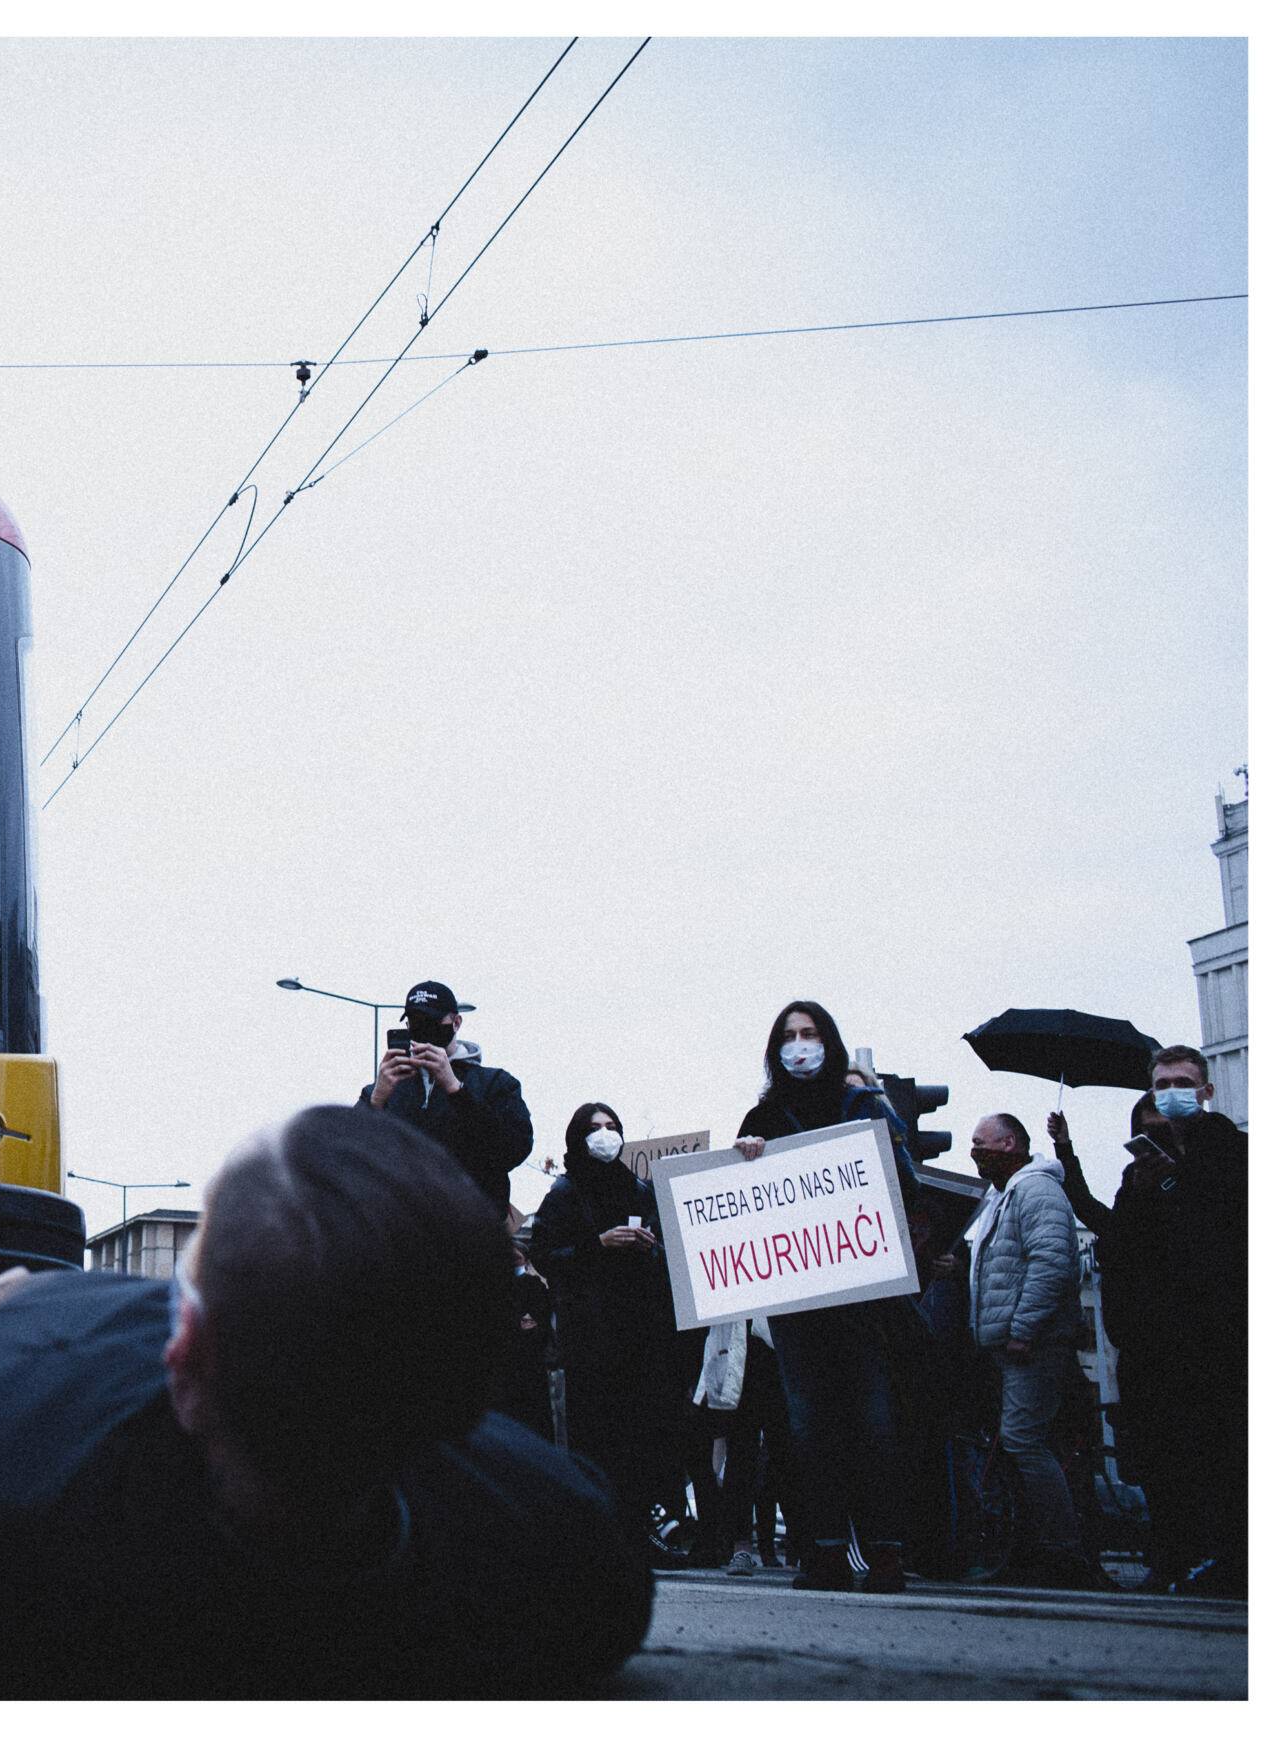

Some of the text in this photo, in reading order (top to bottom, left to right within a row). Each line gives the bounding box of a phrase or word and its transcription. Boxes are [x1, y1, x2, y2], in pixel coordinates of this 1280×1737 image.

[684, 1160, 869, 1226] TRZEBA BYŁO NAS NIE
[700, 1204, 889, 1291] WKURWIAĆ!
